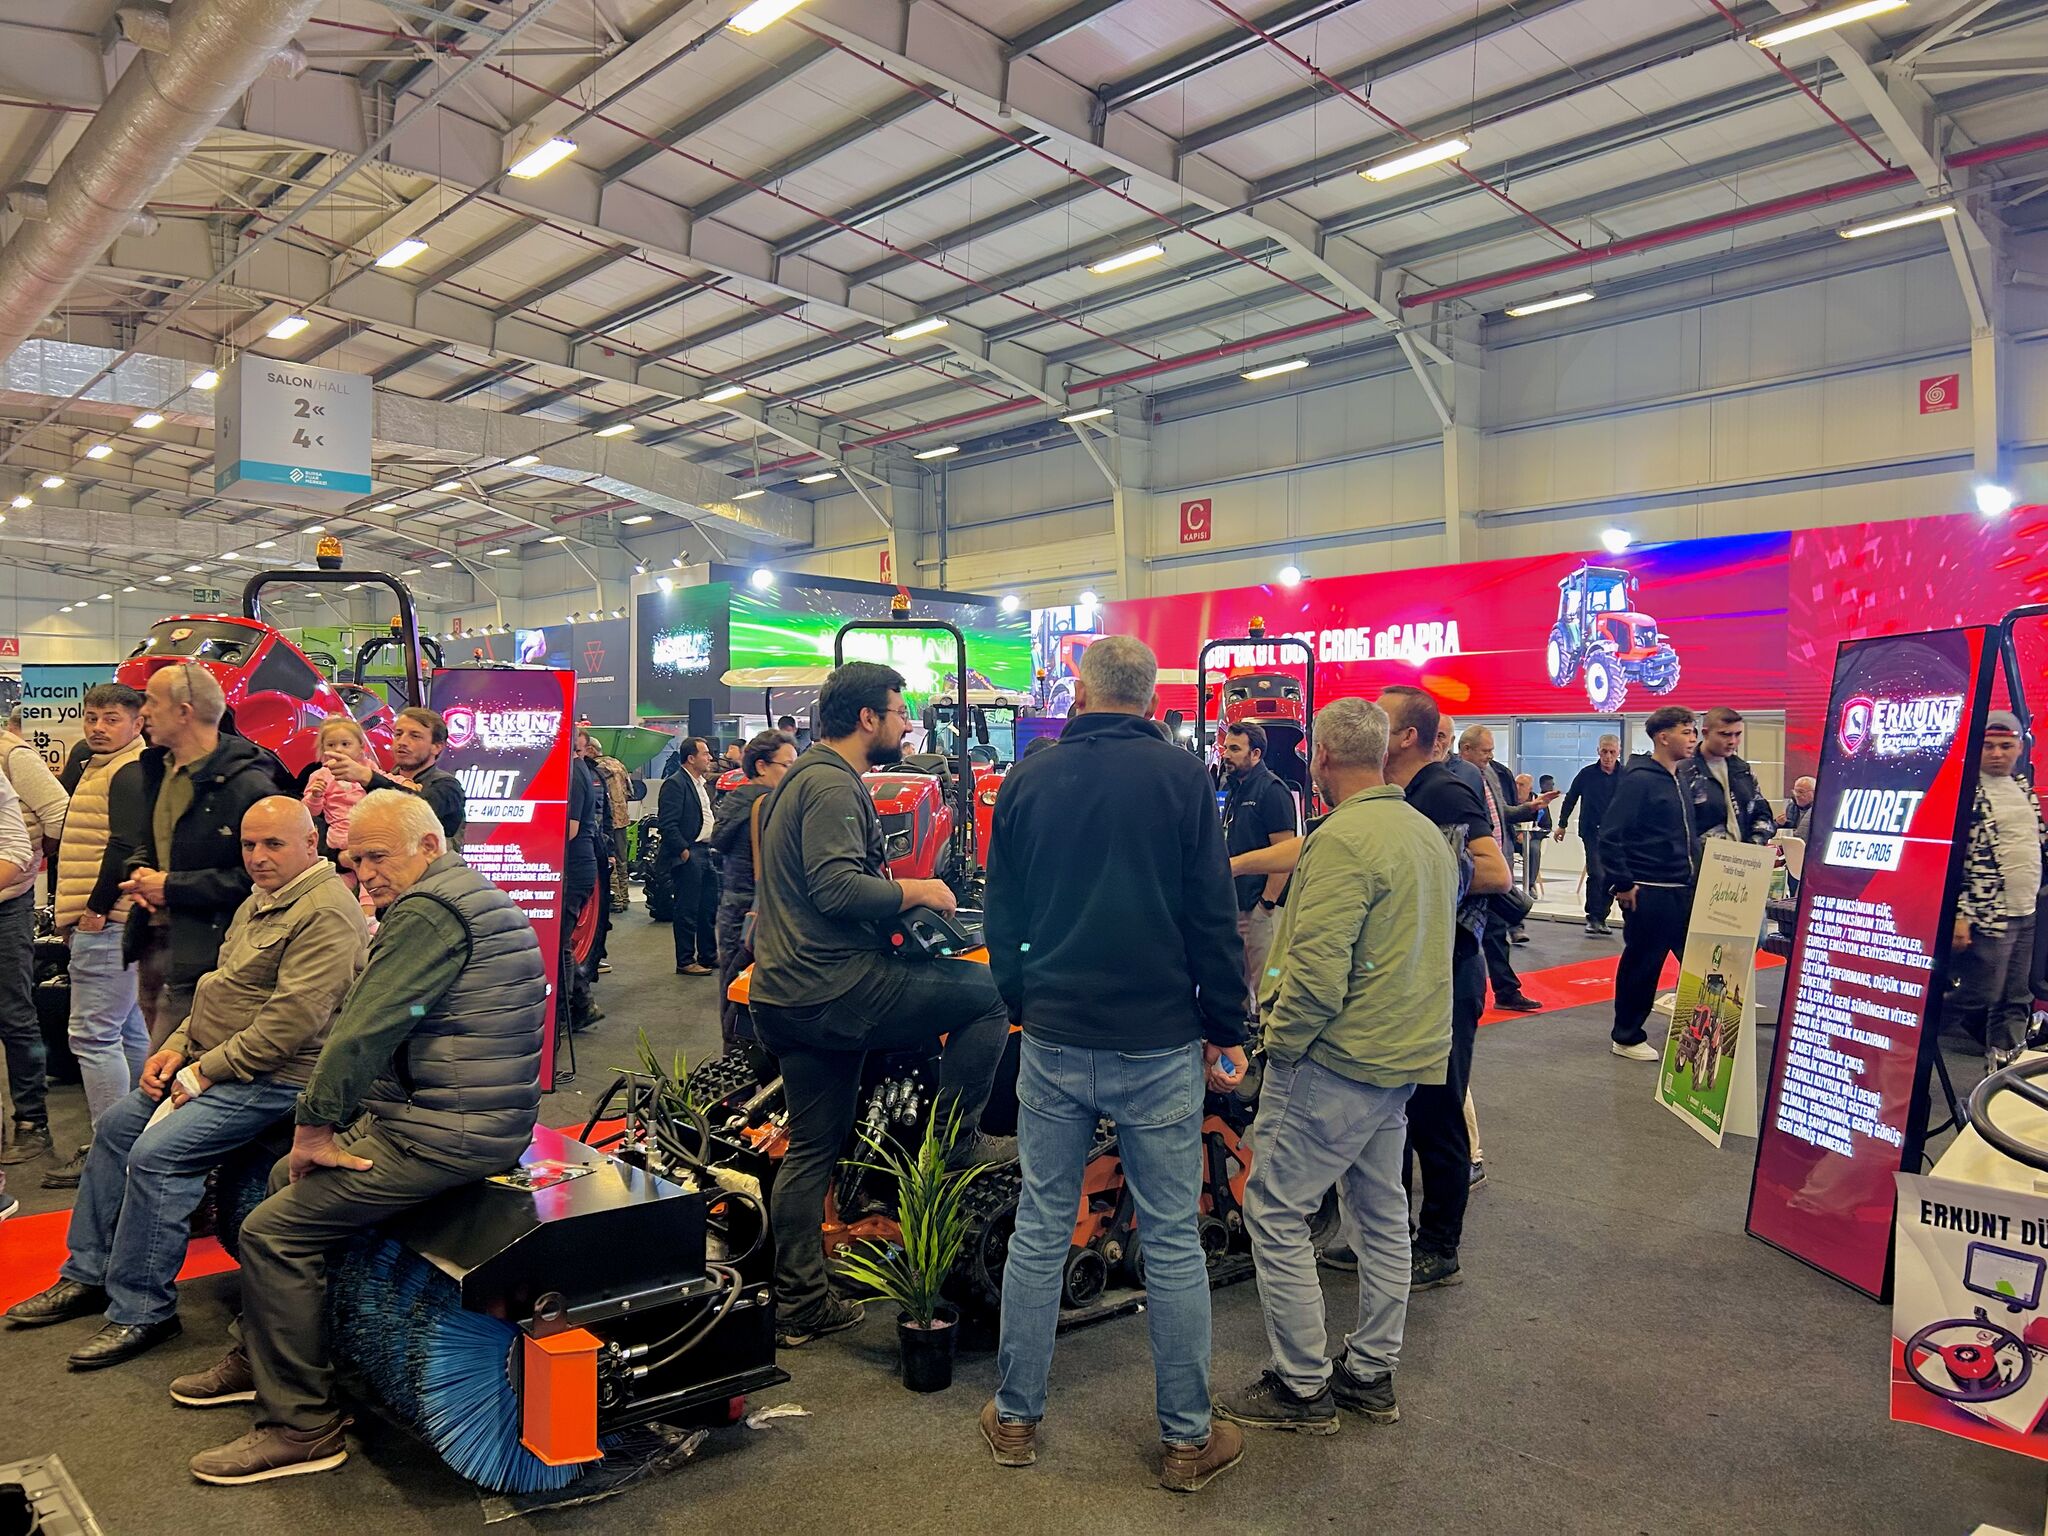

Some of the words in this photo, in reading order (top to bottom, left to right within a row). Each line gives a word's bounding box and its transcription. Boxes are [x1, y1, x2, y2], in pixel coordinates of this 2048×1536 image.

[267, 372, 350, 395] SALON/HALL
[294, 398, 310, 419] 2
[292, 428, 311, 449] 4
[1187, 503, 1204, 530] C
[1183, 531, 1208, 541] KAPISI
[2, 639, 16, 651] A
[1319, 627, 1371, 663] CRD5
[1375, 620, 1460, 661] eCAPRA
[23, 682, 78, 698] Aracın
[23, 706, 52, 719] sen
[58, 702, 85, 723] yol
[478, 711, 561, 734] ERKUNT
[1873, 698, 1961, 733] ERKUNT
[455, 765, 520, 799] NİMET
[481, 805, 501, 817] 4WD
[502, 805, 525, 817] CRD5
[1835, 788, 1924, 833] KUDRET
[1837, 840, 1852, 859] 105
[1866, 842, 1893, 862] CRD5
[1826, 897, 1836, 909] HP
[1836, 898, 1874, 914] MAKSİMUM
[1808, 922, 1813, 932] 4
[1814, 921, 1842, 938] SİLİNDİR
[1847, 928, 1871, 943] TURBO
[1824, 911, 1835, 923] NM
[1836, 912, 1874, 929] MAKSİMUM
[1806, 935, 1829, 949] EURO5
[1829, 938, 1859, 955] EMİSYON
[1859, 944, 1906, 963] SEVİYESİNDE
[1906, 953, 1932, 969] DEUTZ
[1802, 959, 1825, 975] ÜSTÜN
[1825, 965, 1873, 988] PERFORMANS,
[1873, 974, 1899, 993] DÜŞÜK
[1899, 980, 1923, 997] YAKIT
[1796, 999, 1816, 1015] SAHİP
[1798, 986, 1806, 998] 24
[1806, 988, 1824, 1003] İLERİ
[1824, 991, 1833, 1006] 24
[1834, 993, 1851, 1010] GERİ
[1851, 997, 1890, 1019] SÜRÜNGEN
[1890, 1007, 1917, 1027] VİTESE
[1810, 1016, 1821, 1030] KG
[1820, 1018, 1852, 1037] HİDROLİK
[1852, 1028, 1890, 1050] KALDIRMA
[1787, 1052, 1818, 1073] HİDROLİK
[1818, 1060, 1836, 1077] ORTA
[1796, 1041, 1812, 1055] ADET
[1812, 1045, 1845, 1065] HİDROLİK
[1785, 1065, 1791, 1077] 2
[1791, 1067, 1814, 1085] FARKLI
[1814, 1074, 1842, 1094] KUYRUK
[1842, 1081, 1858, 1097] MİLİ
[1783, 1078, 1801, 1093] HAVA
[1801, 1083, 1847, 1110] KOMPRESÖRÜ
[1779, 1105, 1808, 1123] ALANINA
[1808, 1114, 1828, 1131] SAHİP
[1777, 1118, 1793, 1132] GERİ
[1793, 1123, 1816, 1145] GÖRÜŞ
[1852, 1116, 1874, 1137] GENİŞ
[1874, 1123, 1902, 1147] GÖRÜŞ
[1920, 1199, 2011, 1241] ERKUNT
